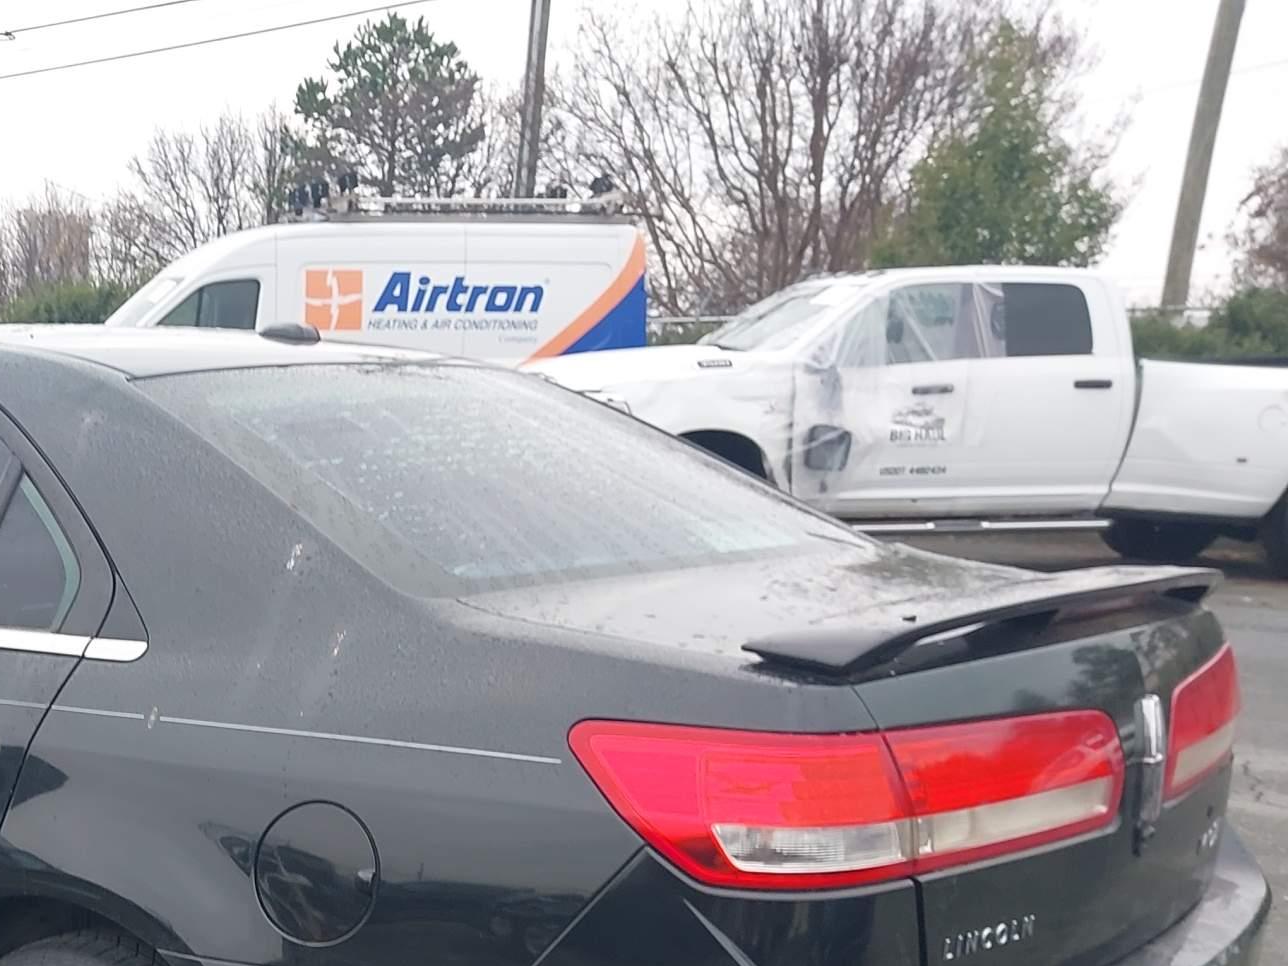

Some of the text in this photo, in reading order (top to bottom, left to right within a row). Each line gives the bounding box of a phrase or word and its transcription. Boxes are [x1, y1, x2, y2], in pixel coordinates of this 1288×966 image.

[372, 271, 545, 313] Airtron
[367, 319, 539, 332] HEATING & AIR CONDITIONING
[943, 914, 1036, 961] LINCOLN
